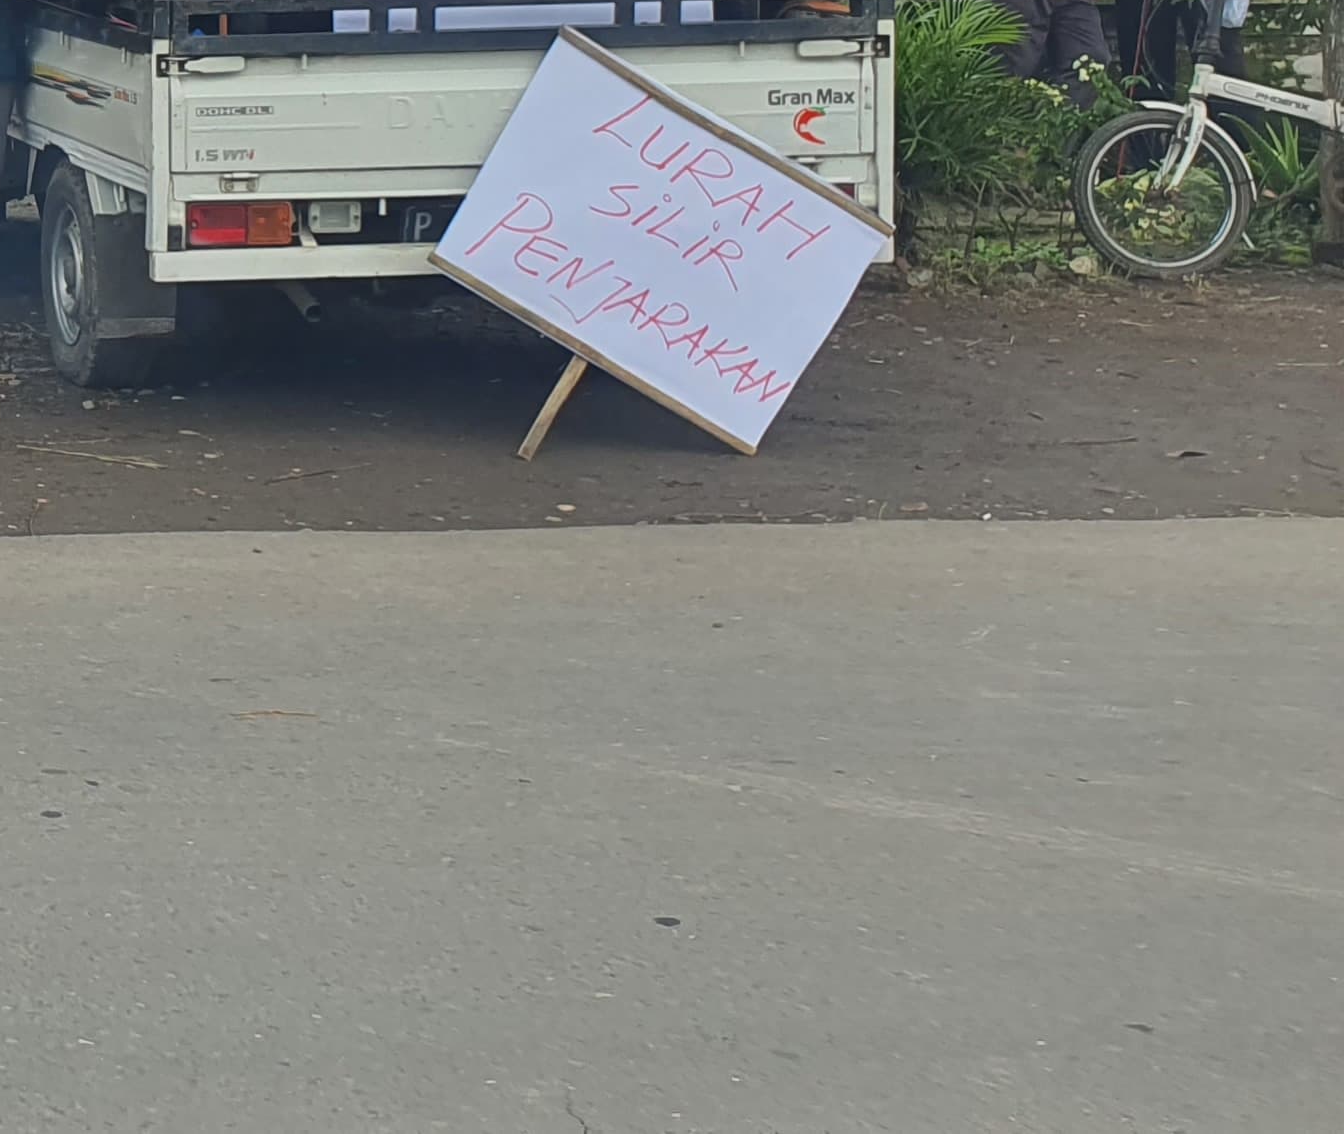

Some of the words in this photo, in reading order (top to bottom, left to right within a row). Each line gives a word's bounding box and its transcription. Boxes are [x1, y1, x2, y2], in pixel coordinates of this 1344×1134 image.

[592, 94, 832, 261] LURAH
[767, 89, 812, 105] Gran
[816, 87, 855, 104] Max
[464, 191, 792, 403] PENJARAKAN
